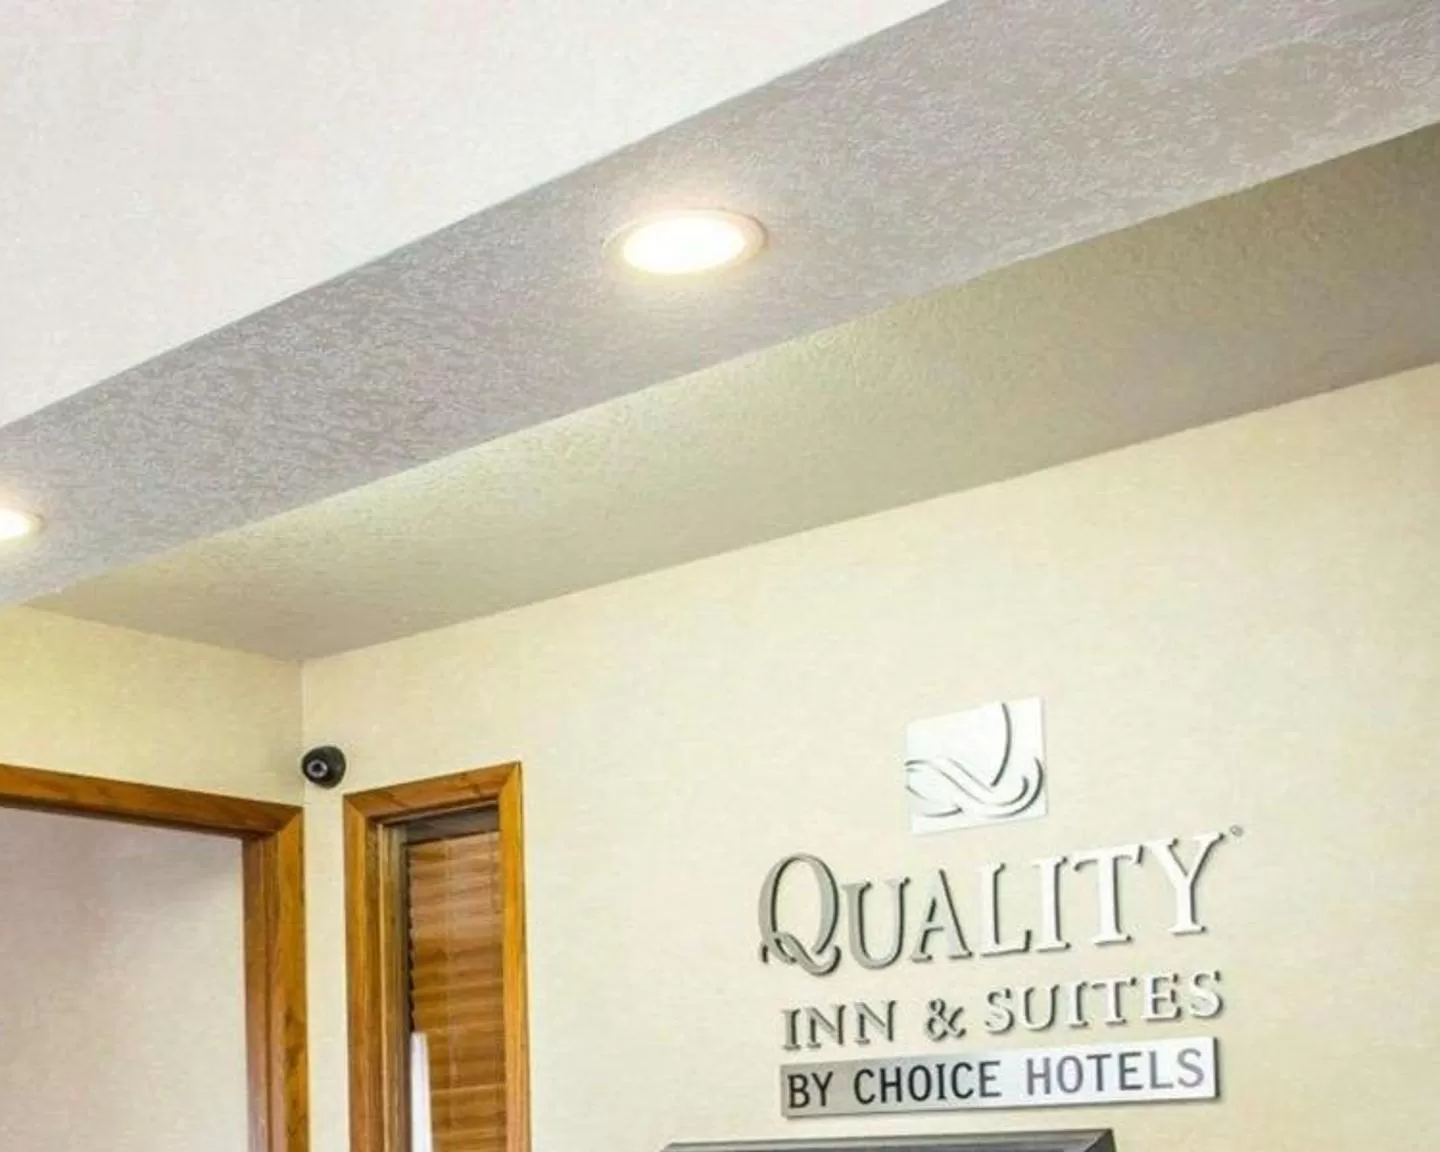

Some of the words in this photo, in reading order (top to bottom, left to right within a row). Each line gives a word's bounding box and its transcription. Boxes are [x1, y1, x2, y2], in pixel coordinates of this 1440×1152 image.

[758, 831, 1226, 977] QUALITY
[782, 1000, 896, 1050] INN
[926, 999, 967, 1041] &
[984, 970, 1224, 1034] SUITES
[787, 1070, 835, 1109] BY
[853, 1060, 1003, 1105] CHOICE
[1026, 1047, 1206, 1097] HOTELS
